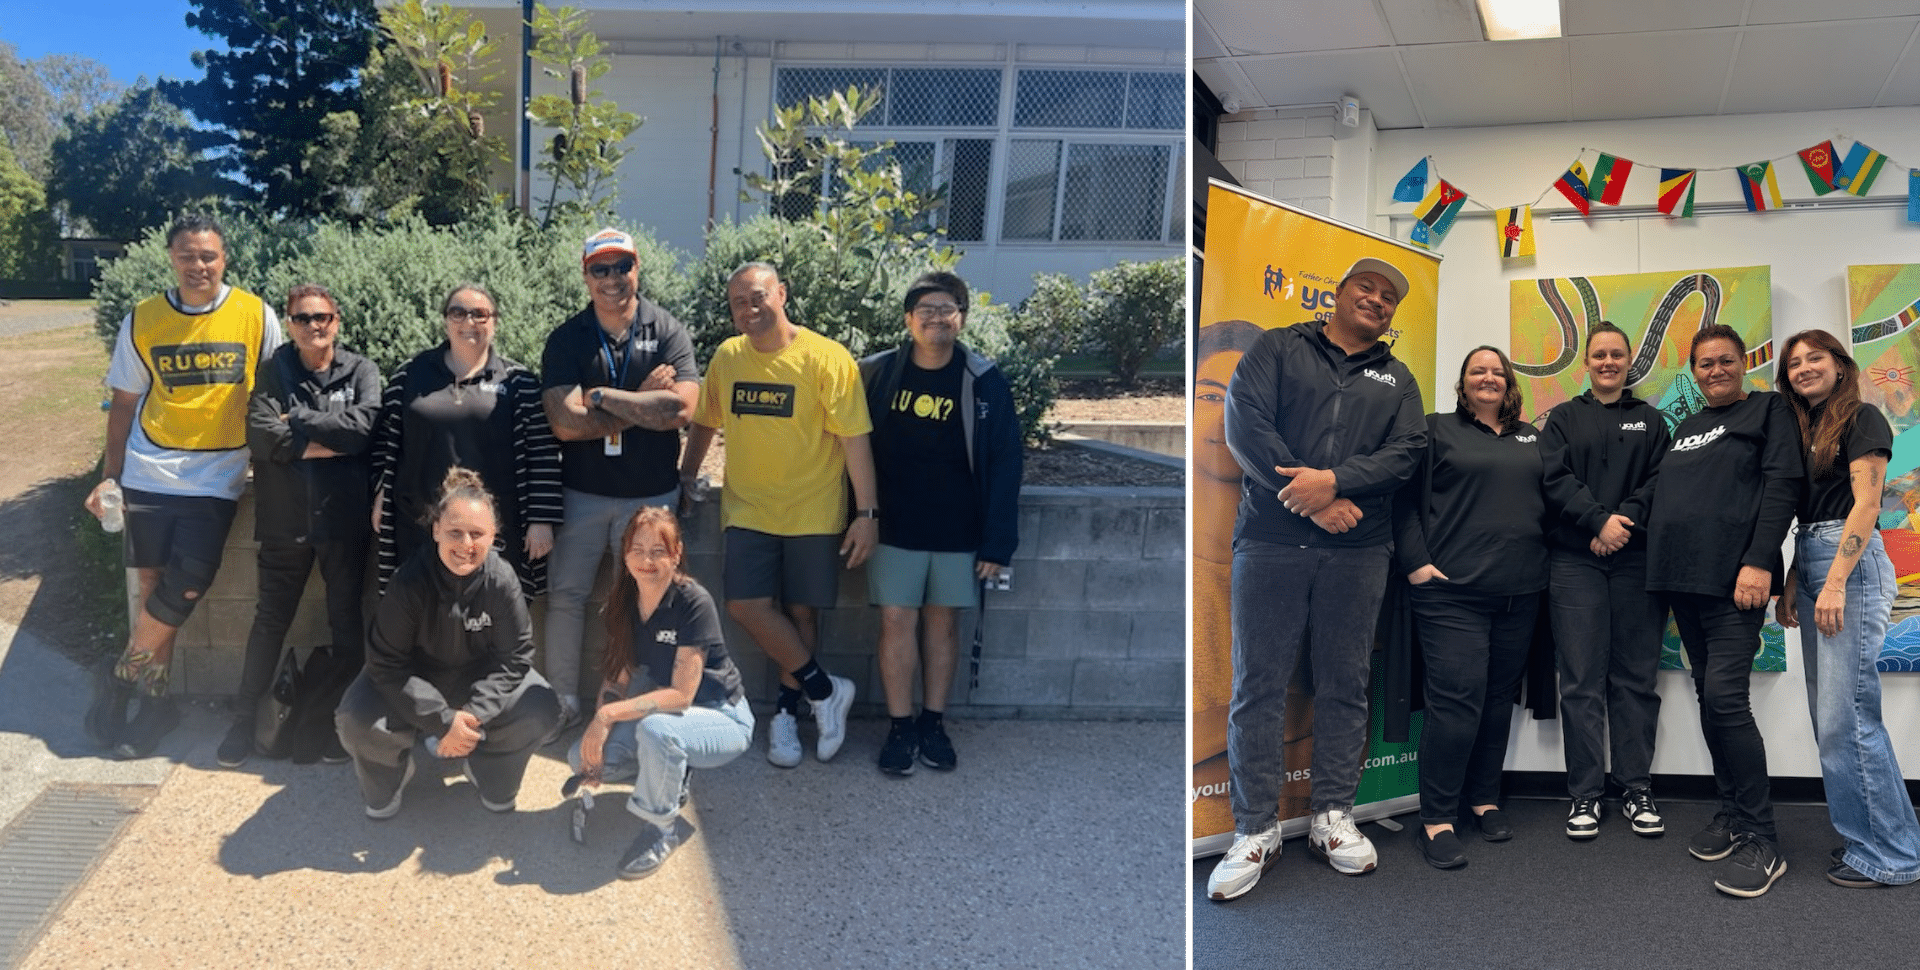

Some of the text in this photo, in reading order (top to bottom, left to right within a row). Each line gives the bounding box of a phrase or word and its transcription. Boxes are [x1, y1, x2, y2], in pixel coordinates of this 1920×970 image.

[1298, 270, 1322, 282] Father
[1363, 368, 1396, 384] youth
[1670, 424, 1727, 452] youth
